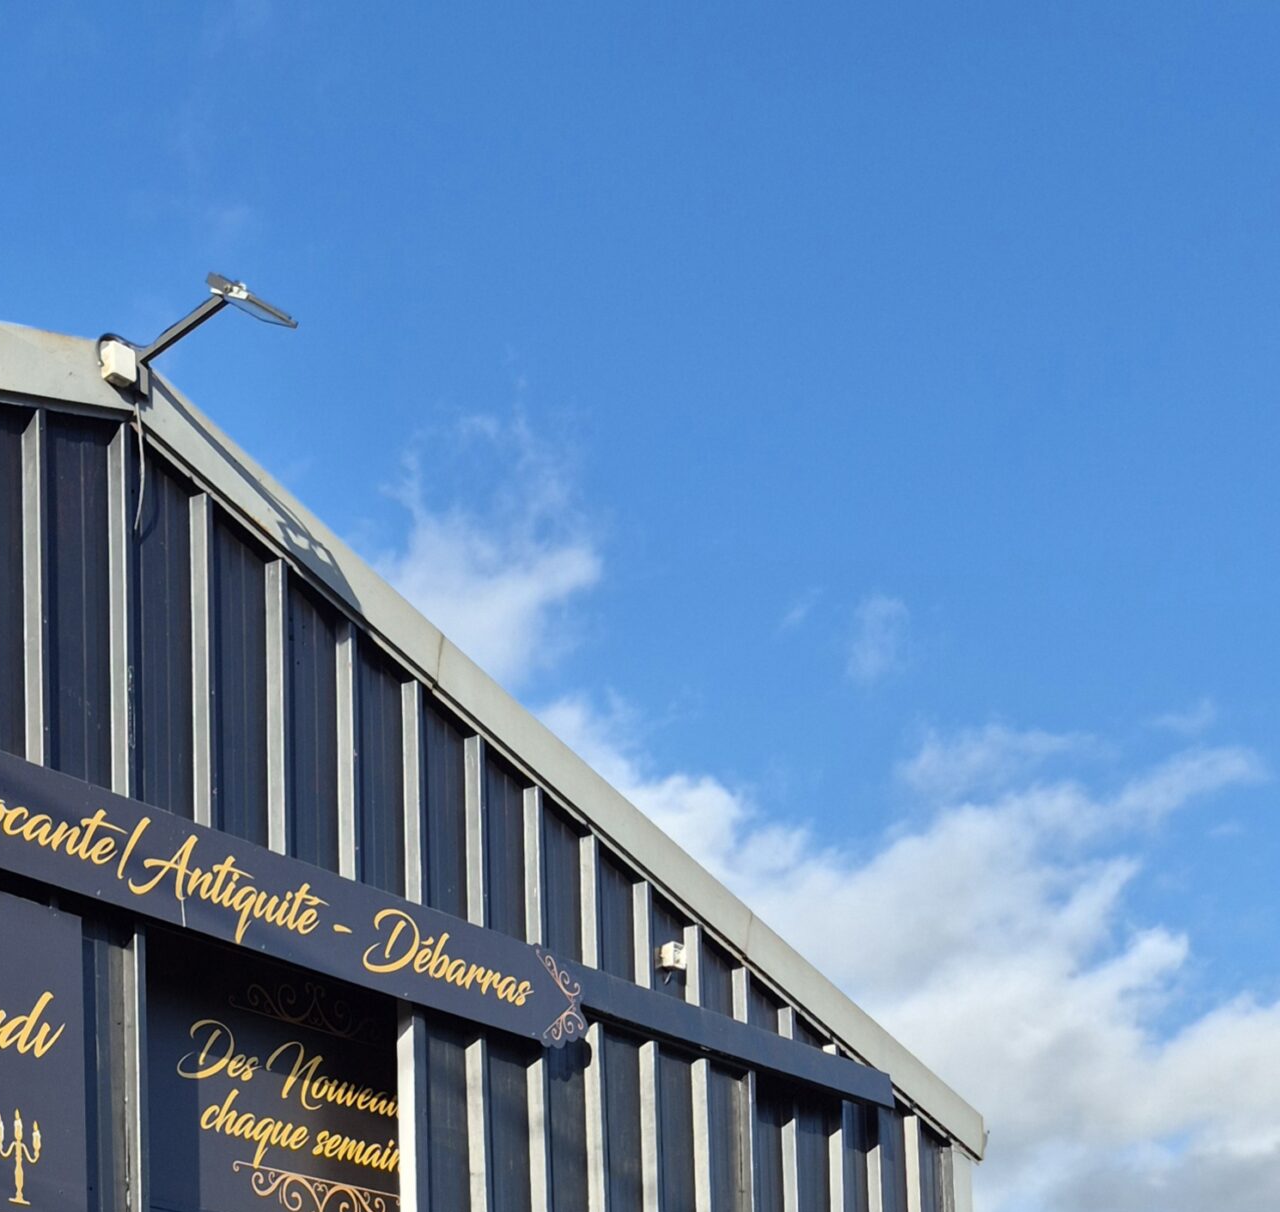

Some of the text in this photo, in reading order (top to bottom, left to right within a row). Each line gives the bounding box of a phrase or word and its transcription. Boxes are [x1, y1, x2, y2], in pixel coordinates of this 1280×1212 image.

[128, 836, 330, 944] Antiquité
[363, 908, 534, 1007] Débarras
[177, 1019, 262, 1082] Des
[200, 1089, 310, 1169] chaque
